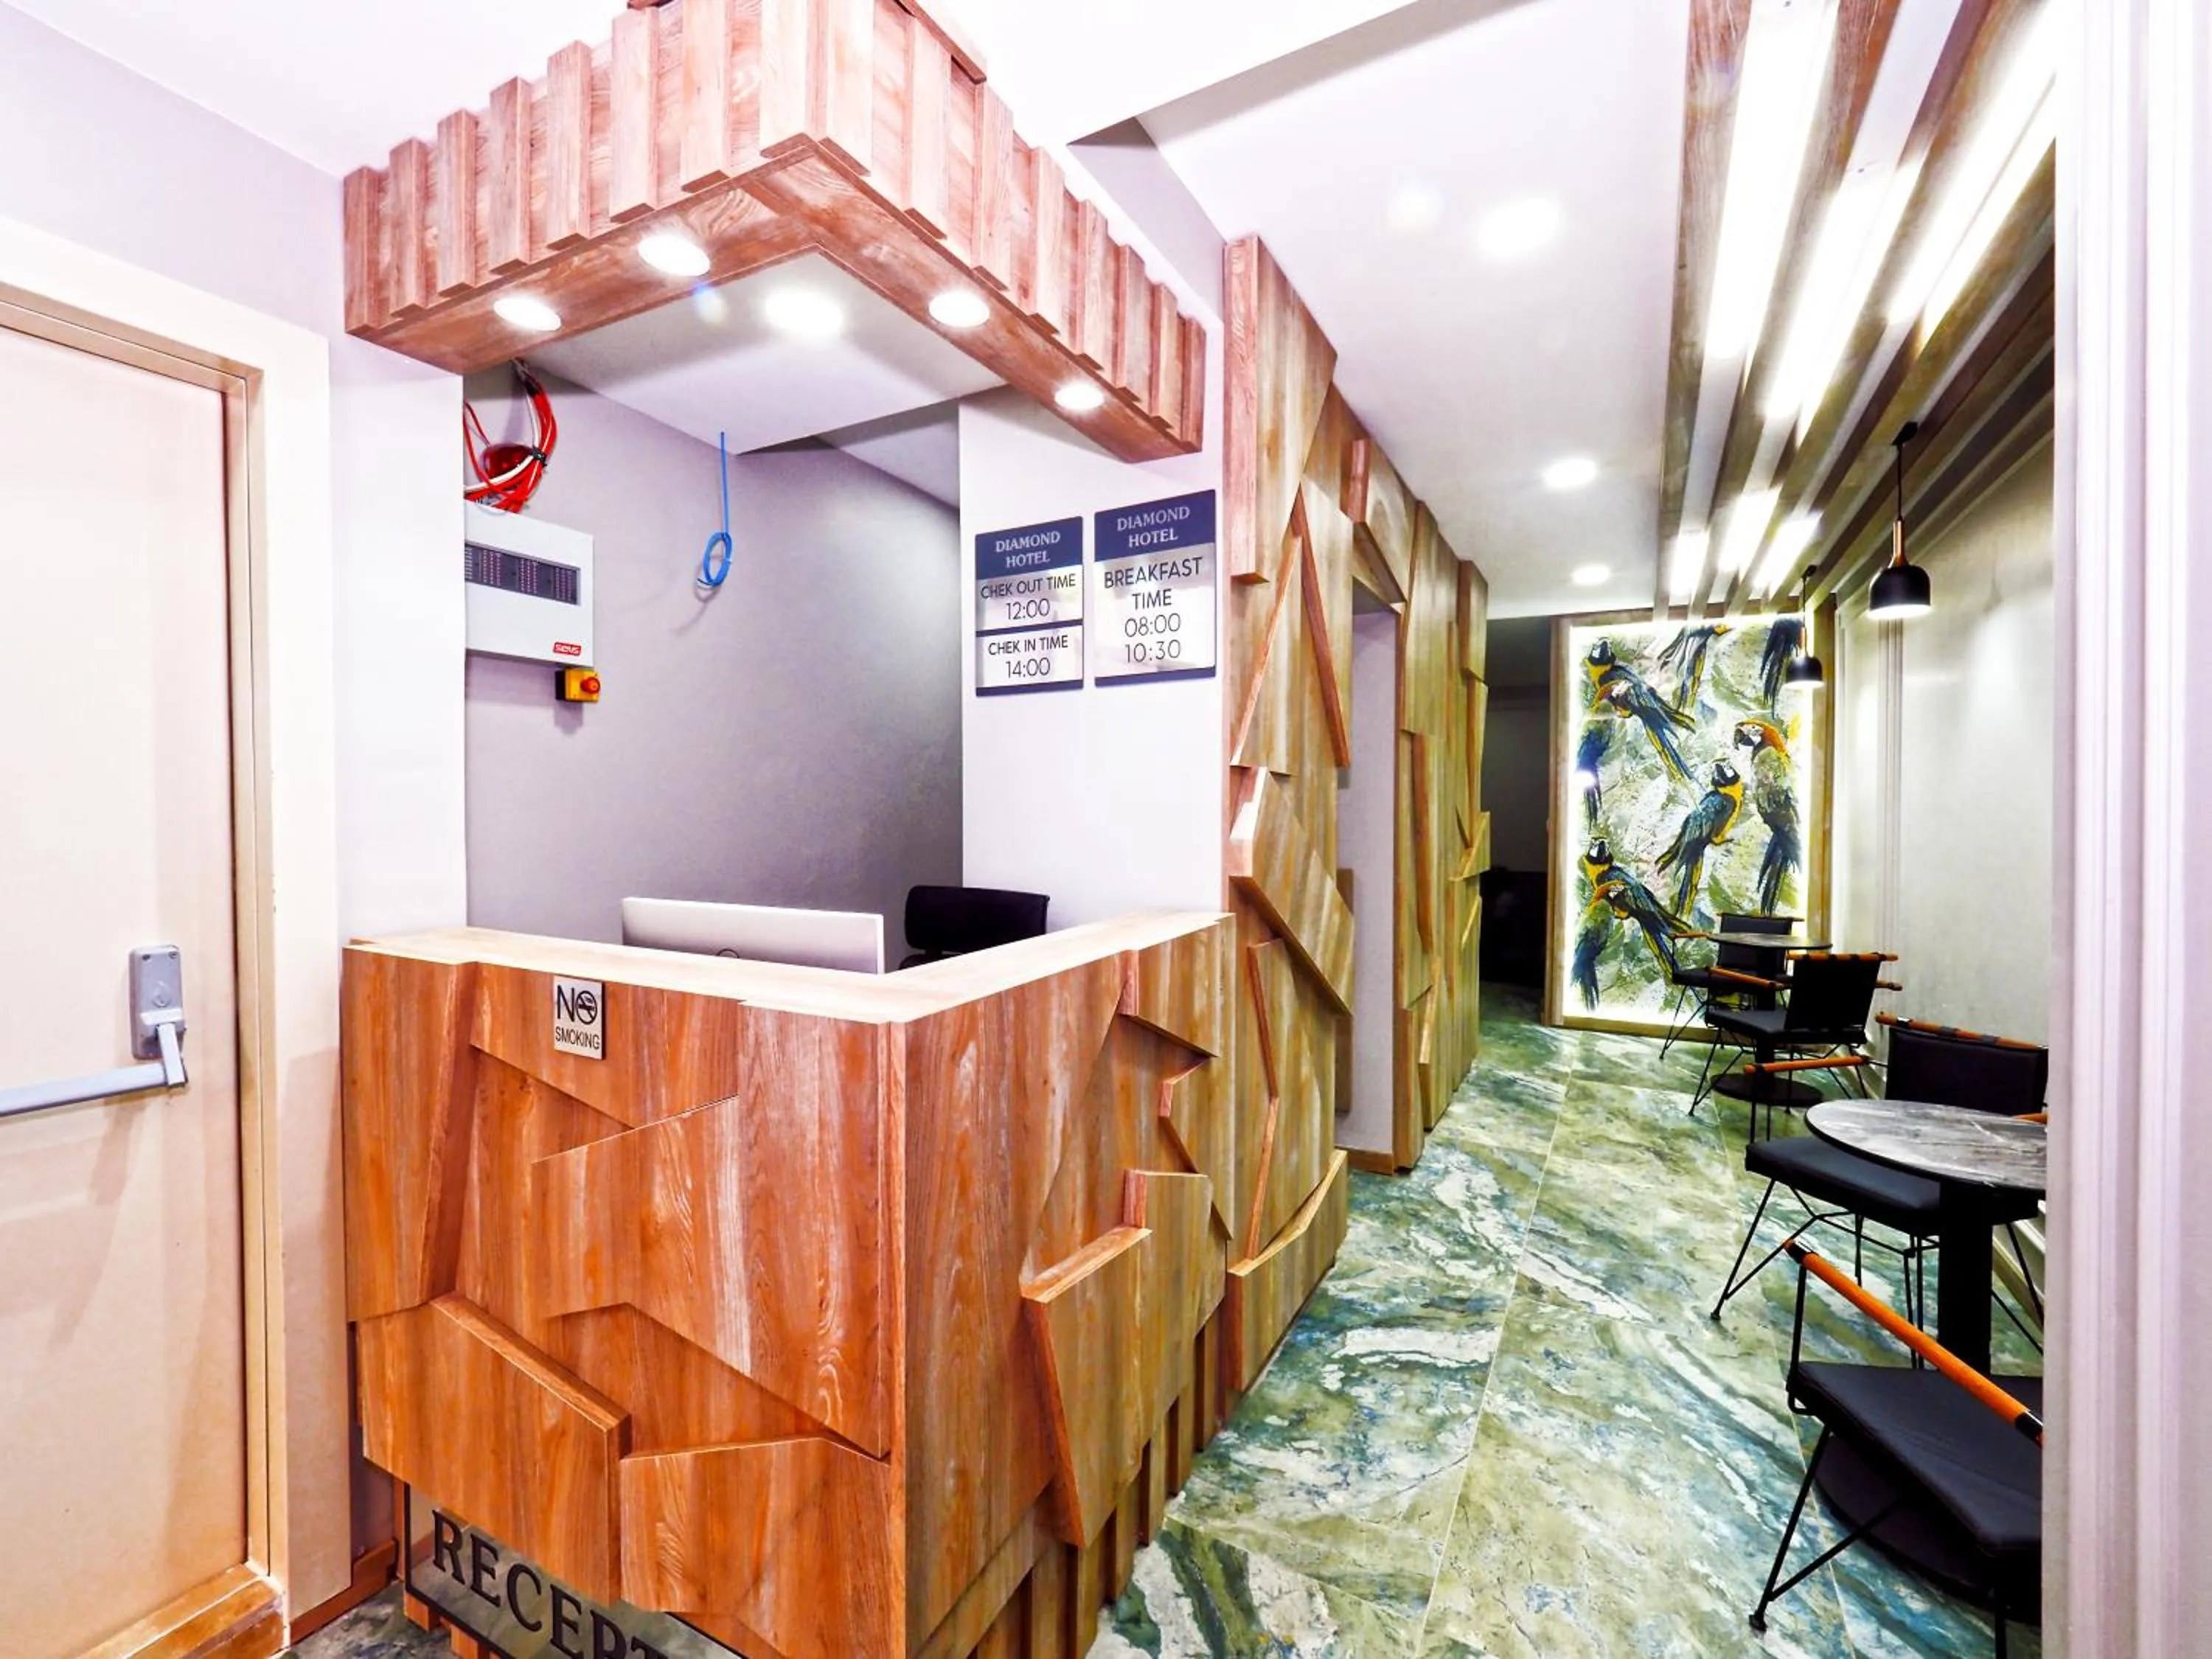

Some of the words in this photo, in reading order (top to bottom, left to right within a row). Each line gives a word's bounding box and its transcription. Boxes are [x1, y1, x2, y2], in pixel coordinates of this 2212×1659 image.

[1117, 506, 1191, 532] DIAMOND
[995, 531, 1060, 552] DIAMOND
[1128, 529, 1178, 548] HOTEL
[1006, 552, 1051, 568] HOTEL
[1104, 557, 1203, 588] BREAKFAST
[981, 584, 1012, 599] CHEK
[1017, 578, 1043, 594] OUT
[1047, 574, 1076, 590] TIME
[1006, 598, 1051, 620] 12:00
[1132, 589, 1172, 611] TIME
[1124, 613, 1181, 637] 08:00
[988, 641, 1020, 655] CHEK
[1024, 639, 1036, 652] IN
[1040, 635, 1068, 650] TIME
[1125, 640, 1181, 663] 10:30
[1006, 658, 1051, 678] 14:00
[555, 1026, 600, 1050] SMOKING
